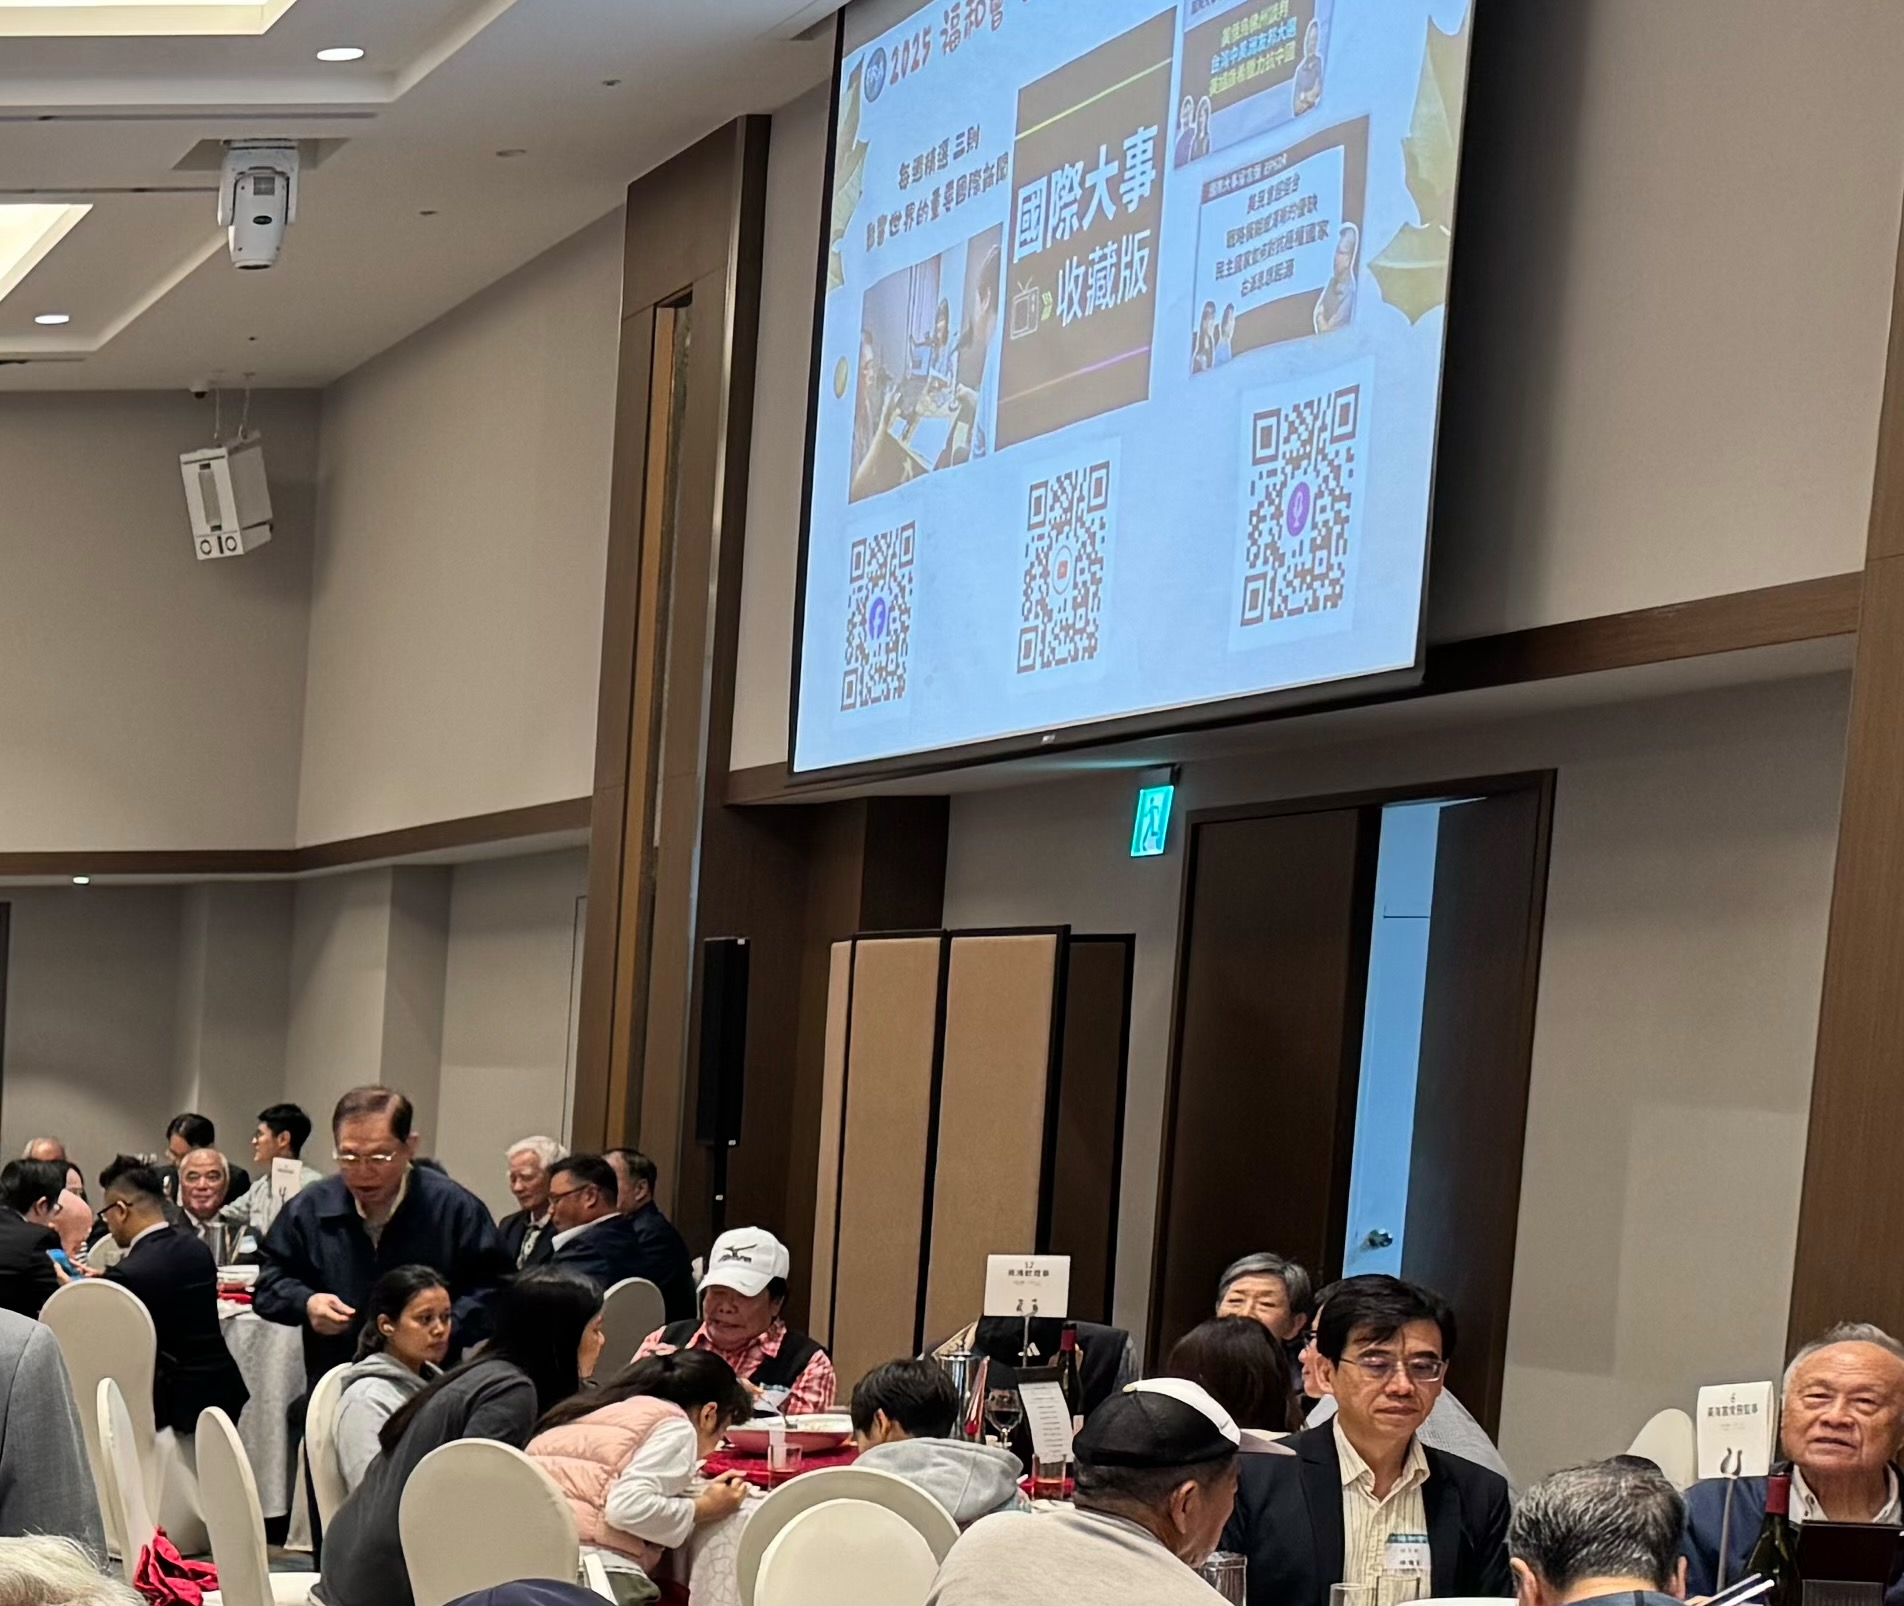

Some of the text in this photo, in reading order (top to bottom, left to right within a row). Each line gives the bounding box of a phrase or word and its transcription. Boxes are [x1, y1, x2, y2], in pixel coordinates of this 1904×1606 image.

[890, 26, 932, 86] 2025
[1013, 124, 1159, 264] 國際大事
[1055, 228, 1152, 328] 收藏版
